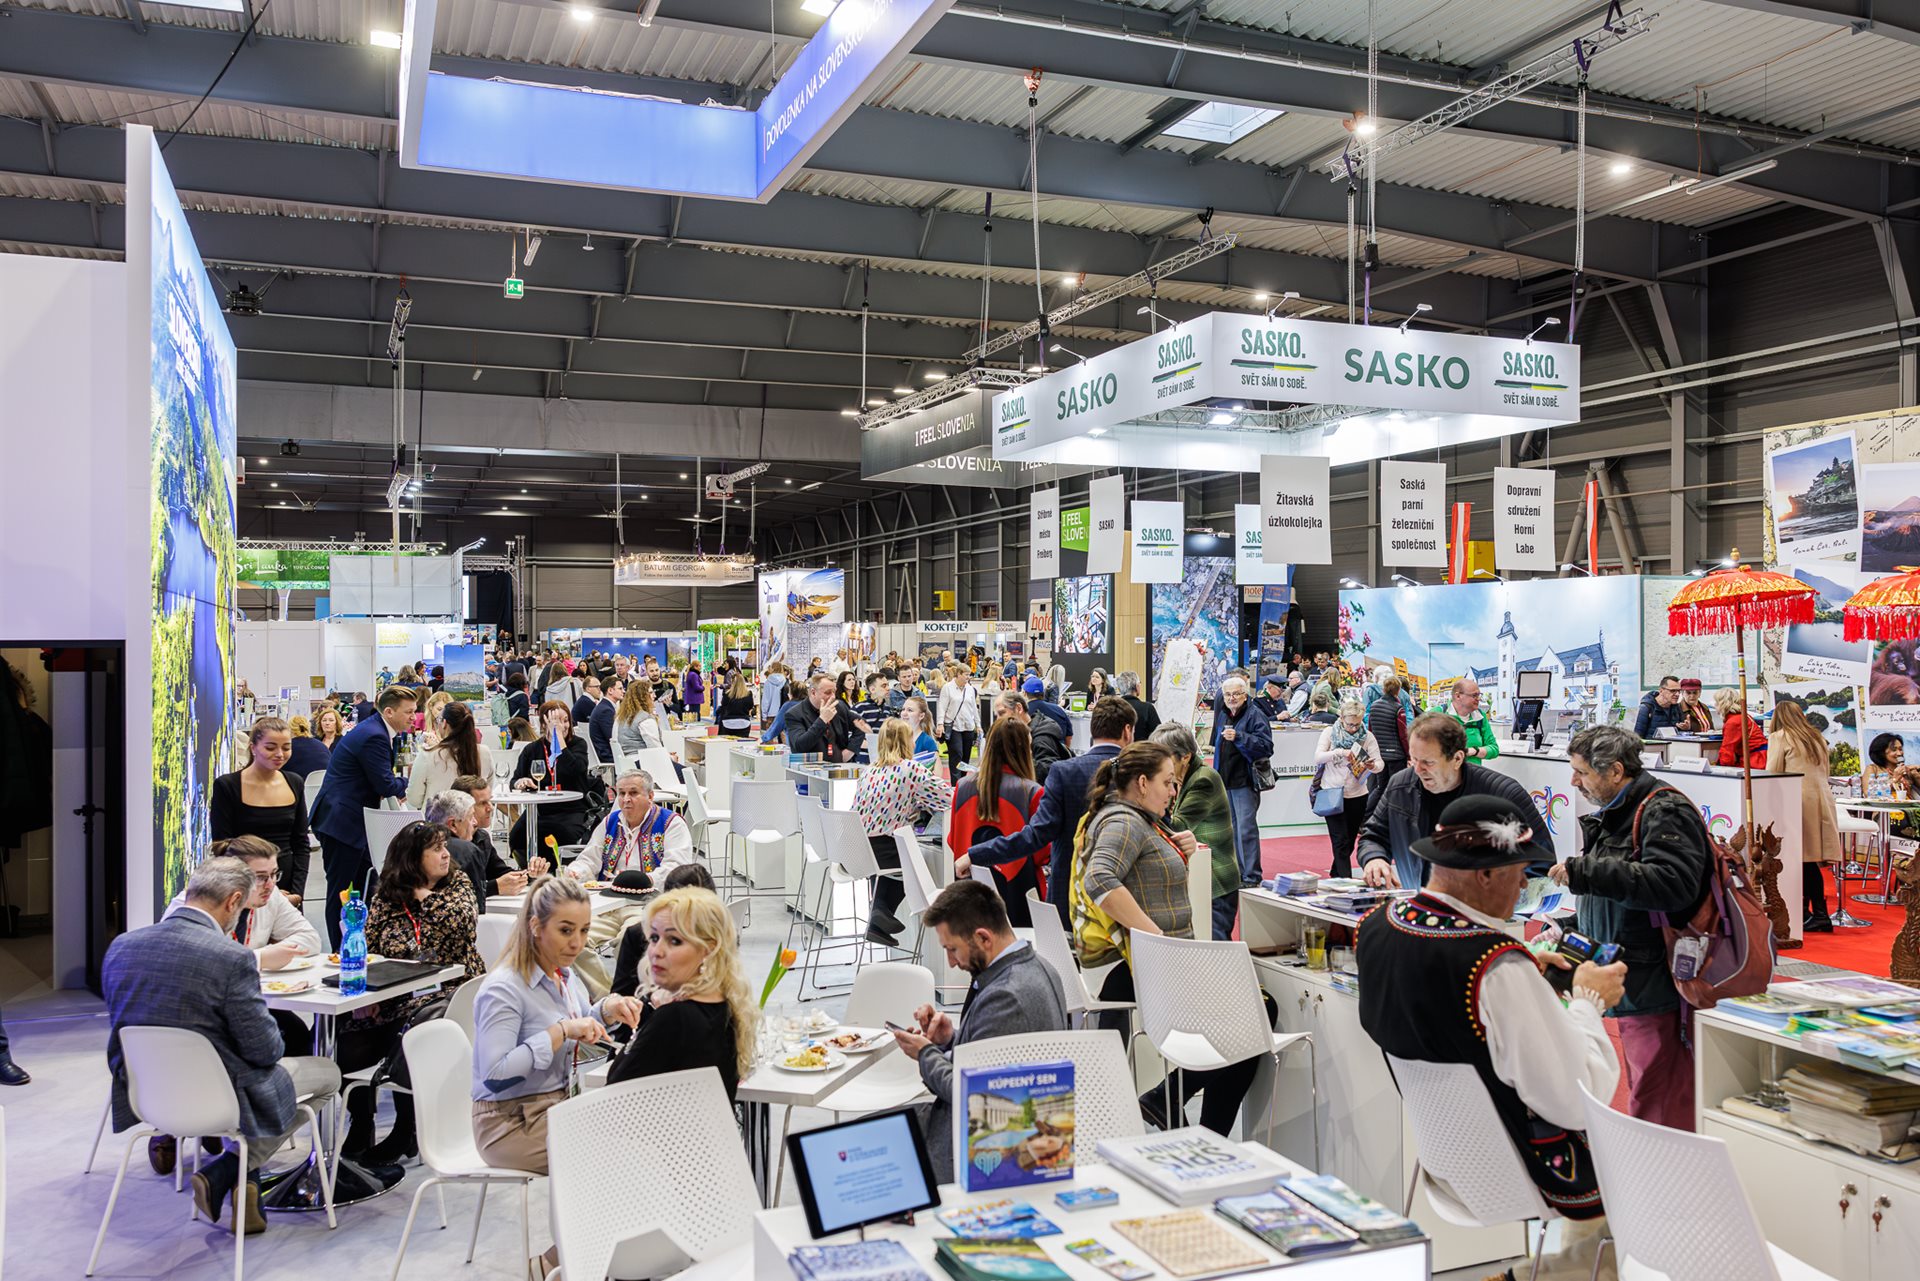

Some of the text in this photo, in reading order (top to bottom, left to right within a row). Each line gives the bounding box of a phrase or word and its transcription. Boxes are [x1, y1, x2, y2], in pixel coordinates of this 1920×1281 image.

[766, 90, 805, 151] DOVOLENKA
[805, 77, 818, 105] NA
[1241, 328, 1306, 358] SASKO.
[1158, 334, 1196, 369] SASKO.
[1344, 348, 1470, 390] SASKO
[1503, 351, 1559, 379] SASKO.
[1241, 372, 1260, 386] SVĚT
[1262, 374, 1278, 388] SÁM
[1280, 378, 1284, 388] O
[1056, 372, 1118, 420] SASKO
[1157, 384, 1168, 399] SVĚT
[1168, 382, 1178, 396] SÁM
[1178, 381, 1182, 392] O
[1503, 392, 1520, 405] SVĚT
[1520, 394, 1535, 406] SÁM
[1536, 398, 1541, 407] O
[1002, 394, 1026, 422] SASKO.
[915, 412, 976, 447] I FEEL SLOVENIA
[927, 455, 1002, 472] SLOVENIA
[1400, 478, 1426, 490] Saská
[1507, 484, 1542, 497] Dopravní
[1276, 492, 1314, 506] Žitavská
[1402, 498, 1424, 511] parní
[1037, 508, 1053, 520] Stříbrné
[1508, 504, 1541, 517] sdružení
[1062, 512, 1082, 527] I FEEL
[1098, 519, 1114, 531] SASKO
[1268, 515, 1322, 529] úzkokolejka
[1392, 518, 1434, 530] železniční
[1038, 528, 1051, 539] město
[1141, 528, 1174, 542] SASKO.
[1514, 523, 1535, 536] Horní
[1246, 530, 1262, 544] SAS
[1391, 538, 1436, 551] společnost
[1515, 542, 1535, 554] Labe
[236, 555, 253, 574] Sri
[254, 554, 288, 576] Lanka
[672, 564, 706, 572] GEORGIA
[924, 622, 964, 633] KOKTEJL
[1300, 764, 1310, 772] SÁM
[1036, 1073, 1057, 1085] SEN
